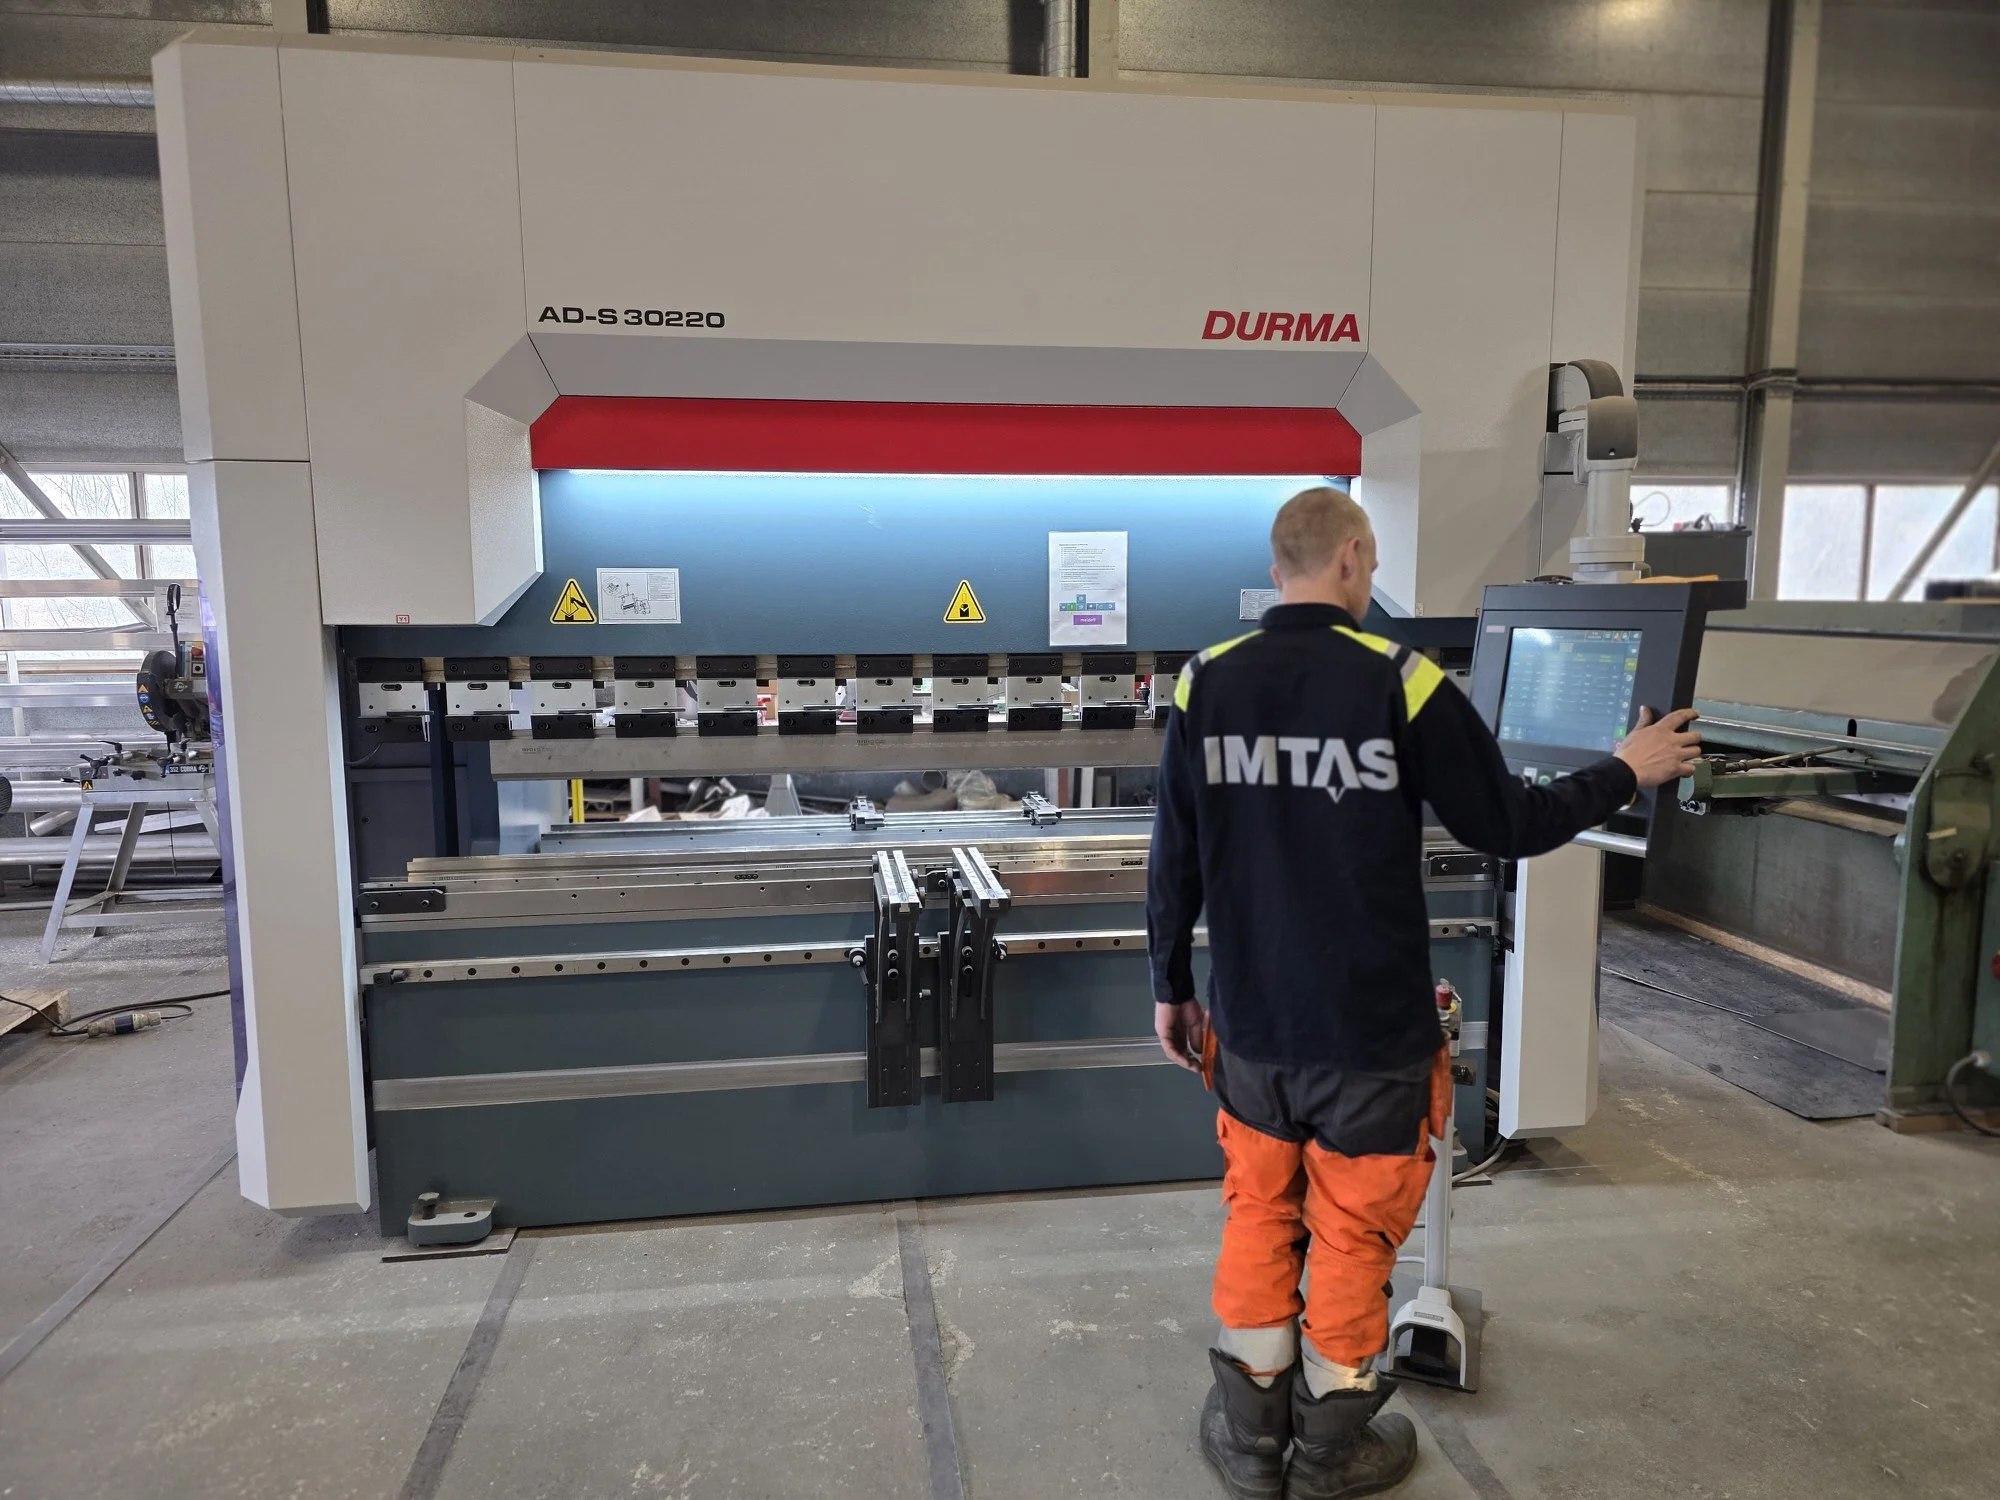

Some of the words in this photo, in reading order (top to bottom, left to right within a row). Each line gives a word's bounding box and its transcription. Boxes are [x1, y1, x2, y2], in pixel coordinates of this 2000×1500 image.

[538, 306, 618, 325] AD-S
[624, 309, 726, 329] 30220
[1202, 310, 1361, 343] DURMA
[1203, 735, 1400, 803] IMTAS
